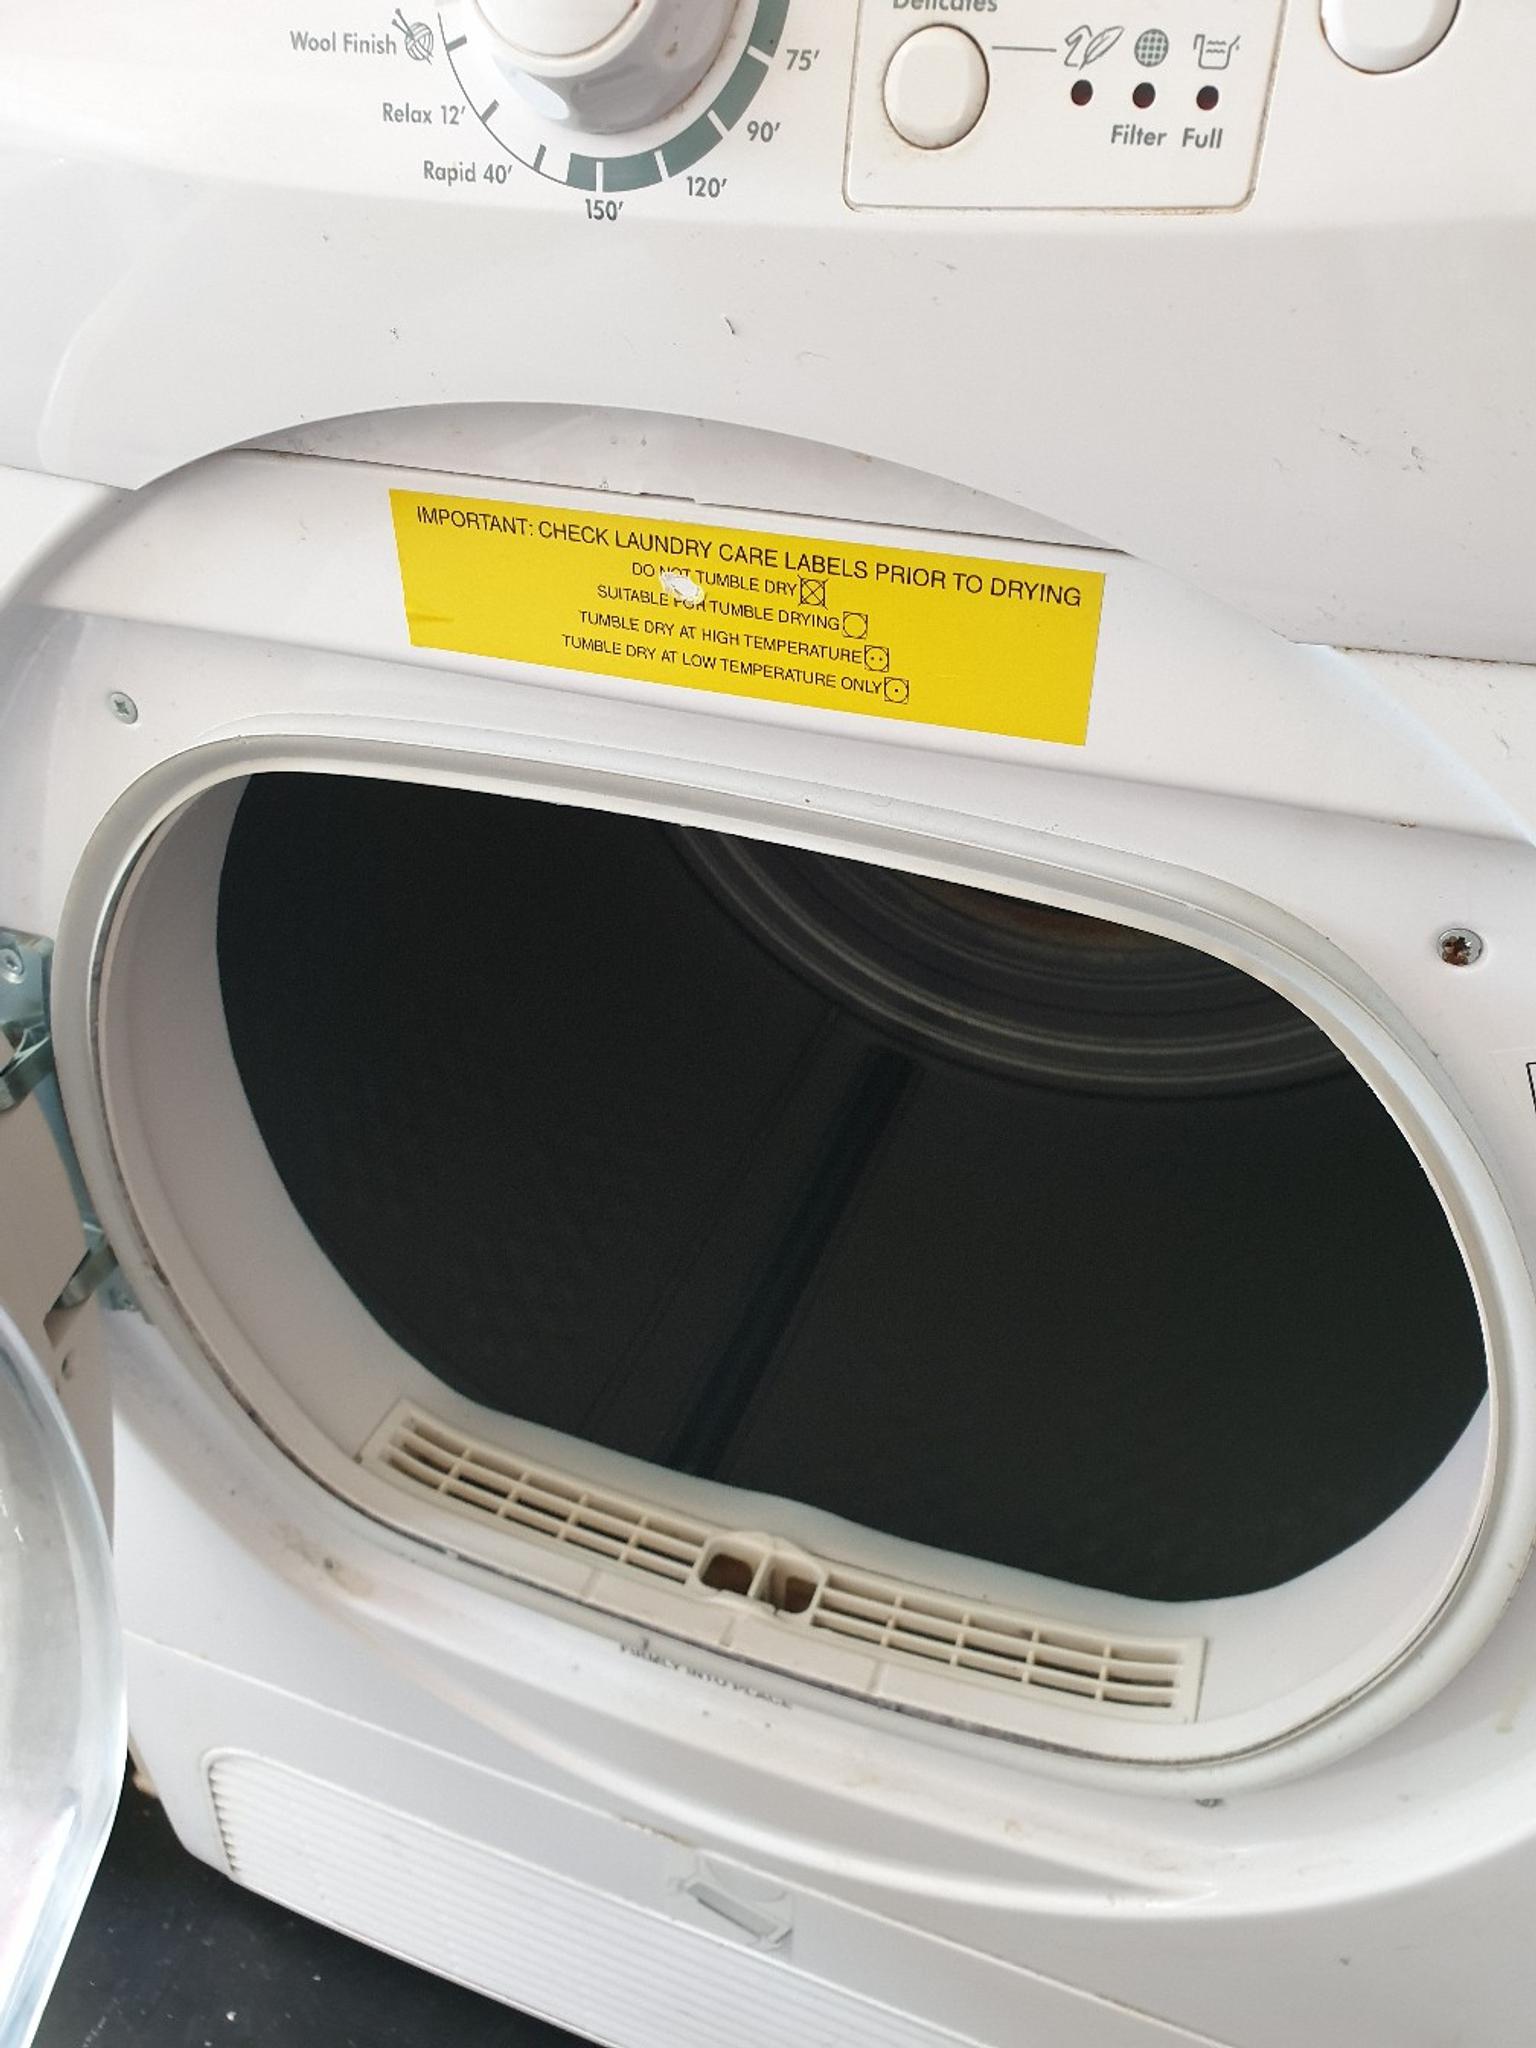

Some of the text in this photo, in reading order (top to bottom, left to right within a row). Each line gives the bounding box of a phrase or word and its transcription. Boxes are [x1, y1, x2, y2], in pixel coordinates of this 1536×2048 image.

[290, 31, 397, 55] Wool Finish
[382, 103, 433, 124] Relax
[1111, 125, 1224, 150] Filter Full
[423, 161, 476, 185] Rapid
[417, 506, 1082, 607] IMPORTANT: CHECK LAUNDRY CARE LABELS PRIOR TO DRYING
[632, 562, 656, 578] DO
[695, 570, 760, 593] TUMBLE
[765, 579, 798, 598] DRY
[597, 584, 669, 607] SUITABLE
[709, 600, 774, 621] TUMBLE
[778, 609, 840, 631] DRYING
[579, 609, 862, 664] TUMBLE DRY AT HIGH TEMPERATURE
[561, 633, 883, 695] TUMBLE DRY AT LOW TEMPERATURE ONLY
